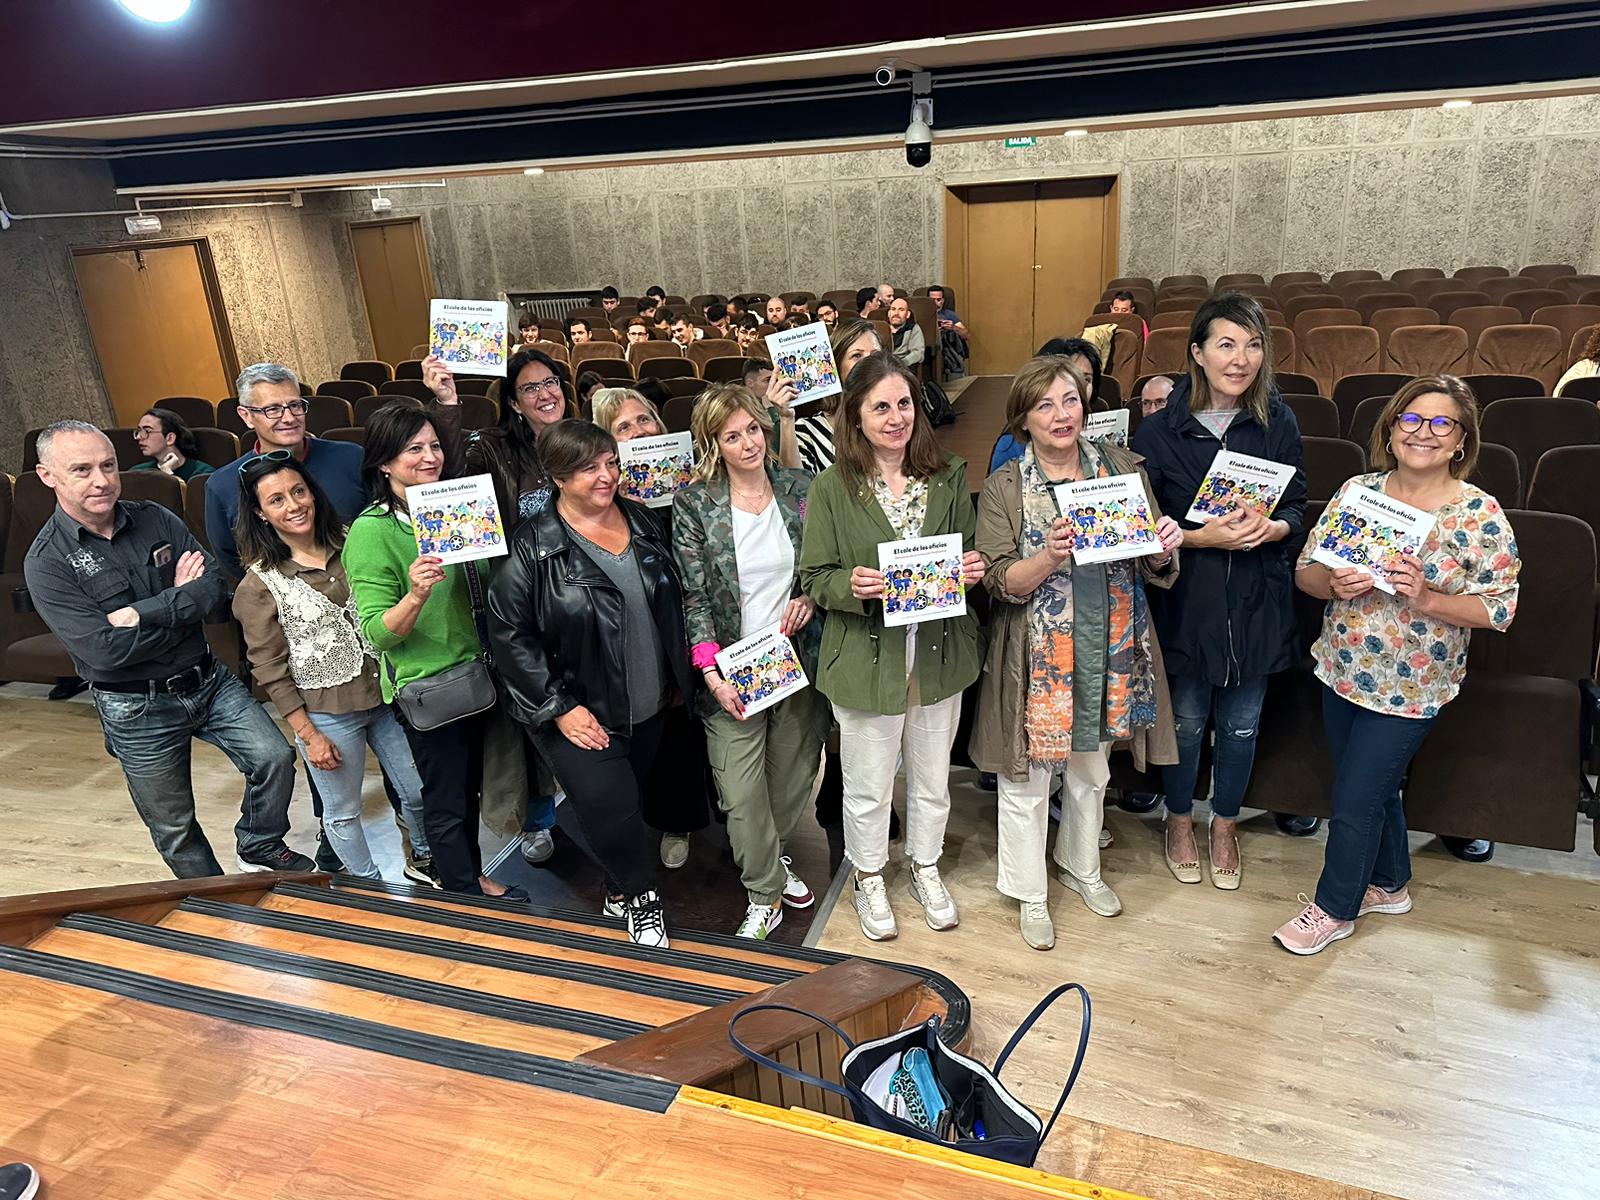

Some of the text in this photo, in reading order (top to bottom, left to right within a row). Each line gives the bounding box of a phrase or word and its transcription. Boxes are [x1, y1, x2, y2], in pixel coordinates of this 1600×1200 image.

[1008, 136, 1032, 145] SALIDA
[1261, 468, 1279, 476] oficios
[1366, 498, 1379, 506] cole
[1387, 506, 1396, 514] los
[1396, 510, 1417, 522] oficios
[735, 648, 745, 656] cole
[758, 633, 773, 643] oficios
